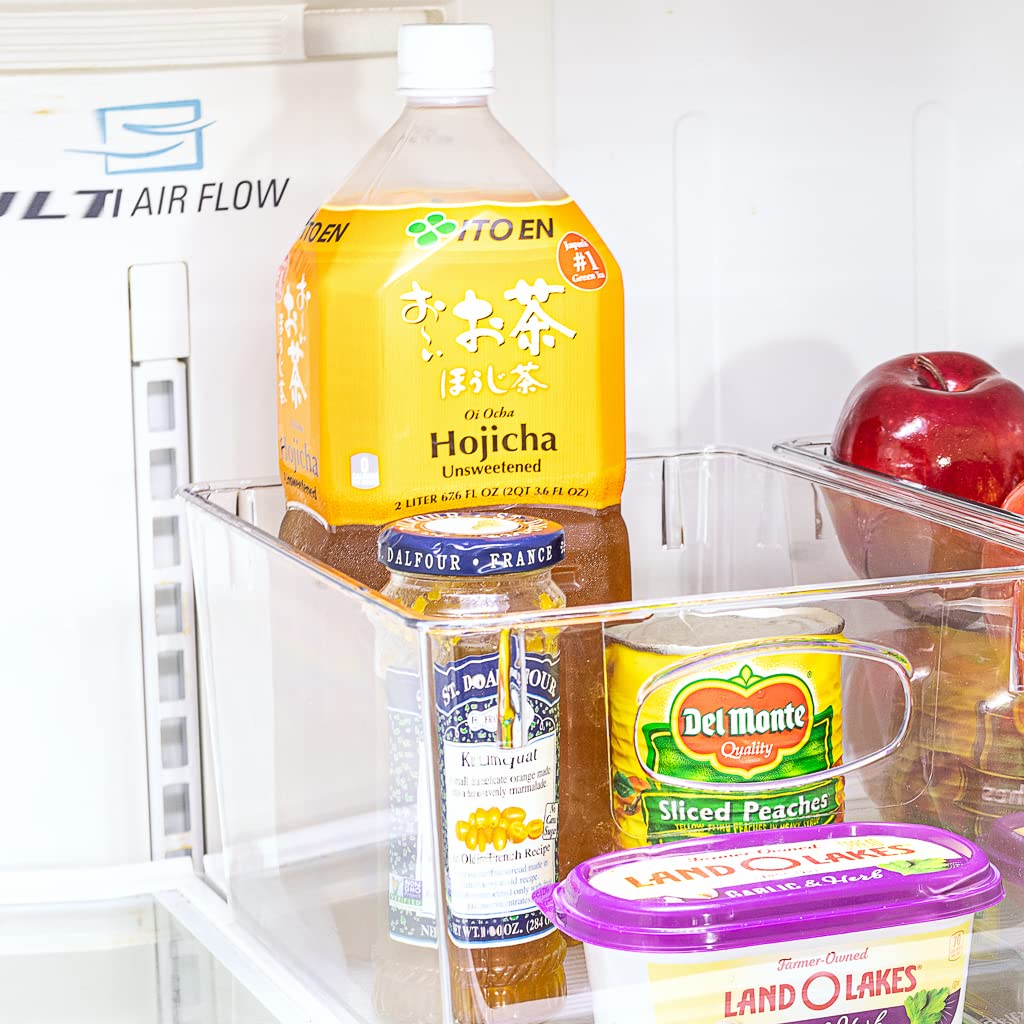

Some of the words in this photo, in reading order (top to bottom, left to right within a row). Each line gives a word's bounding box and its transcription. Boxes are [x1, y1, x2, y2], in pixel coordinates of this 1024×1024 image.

[130, 185, 188, 217] AIR
[197, 177, 290, 213] FLOW
[317, 222, 351, 243] EN
[457, 218, 514, 242] ITO
[518, 217, 554, 241] EN
[573, 250, 600, 273] #1
[464, 409, 480, 421] Oi
[483, 407, 515, 420] Ocha
[431, 423, 558, 462] Hojicha
[442, 459, 541, 479] Unsweetened
[395, 501, 402, 511] 2
[406, 494, 438, 508] LITER
[466, 489, 477, 499] FL
[482, 487, 499, 497] OZ
[553, 487, 564, 496] FL
[568, 486, 589, 498] OZ)
[387, 546, 461, 571] DALFOUR
[490, 545, 553, 569] FRANCE
[442, 681, 460, 707] ST.
[681, 707, 726, 737] Del
[728, 704, 806, 736] Monte
[720, 741, 774, 760] Quality
[658, 799, 731, 822] Sliced
[743, 793, 828, 822] Peaches
[525, 844, 551, 859] Recipe
[624, 865, 736, 888] LAND
[740, 856, 802, 872] O
[802, 844, 916, 865] LAKES
[725, 882, 801, 898] GARLIC
[804, 877, 823, 888] &
[821, 869, 883, 885] Herb
[776, 947, 869, 971] Farmer-Owned
[724, 984, 795, 1018] LAND
[801, 971, 841, 1011] O
[846, 964, 918, 1001] LAKES
